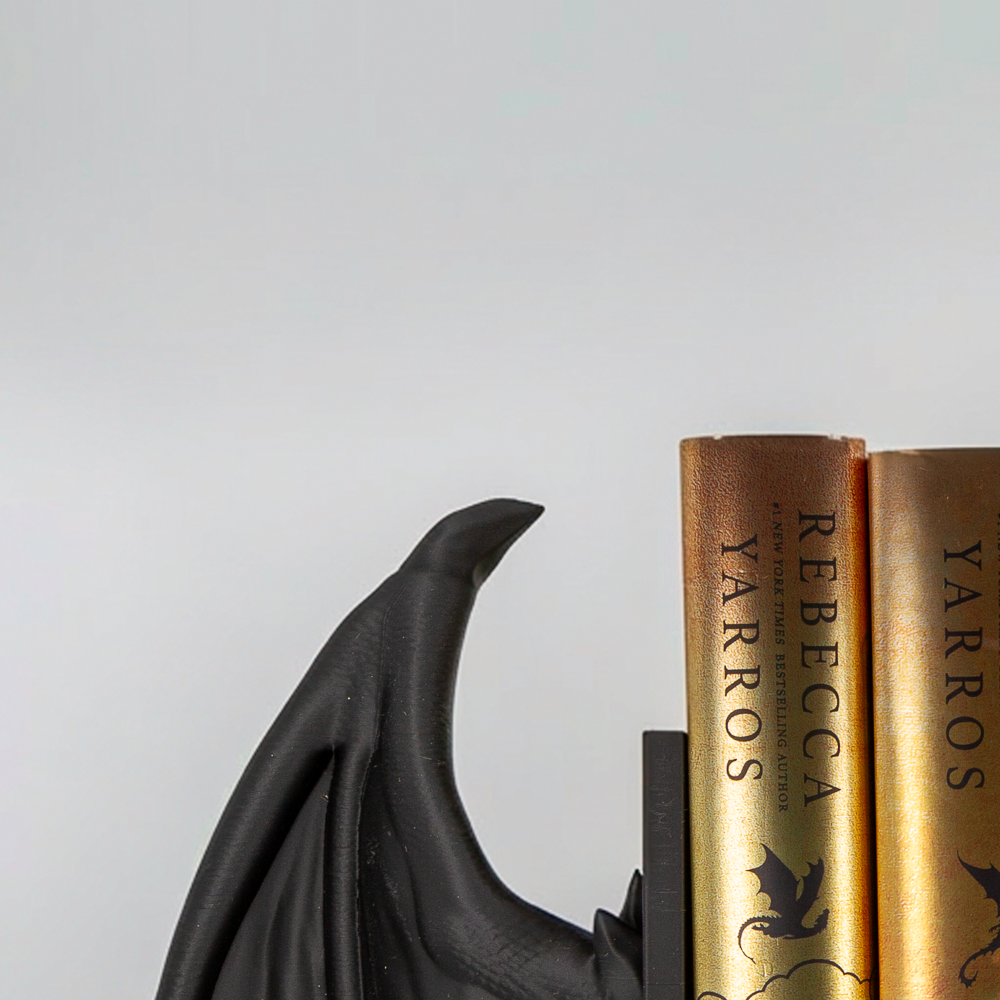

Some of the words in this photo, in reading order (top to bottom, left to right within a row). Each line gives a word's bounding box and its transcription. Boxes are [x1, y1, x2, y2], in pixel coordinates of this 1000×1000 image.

[772, 502, 781, 516] #1
[773, 521, 783, 554] NEW
[774, 559, 784, 596] YORK
[775, 602, 785, 645] TIMES
[721, 533, 763, 781] YARROS
[798, 509, 841, 807] REBECCA
[943, 540, 985, 790] YARROS
[775, 653, 787, 748] BESTSELLING
[777, 753, 788, 812] AUTHOR
